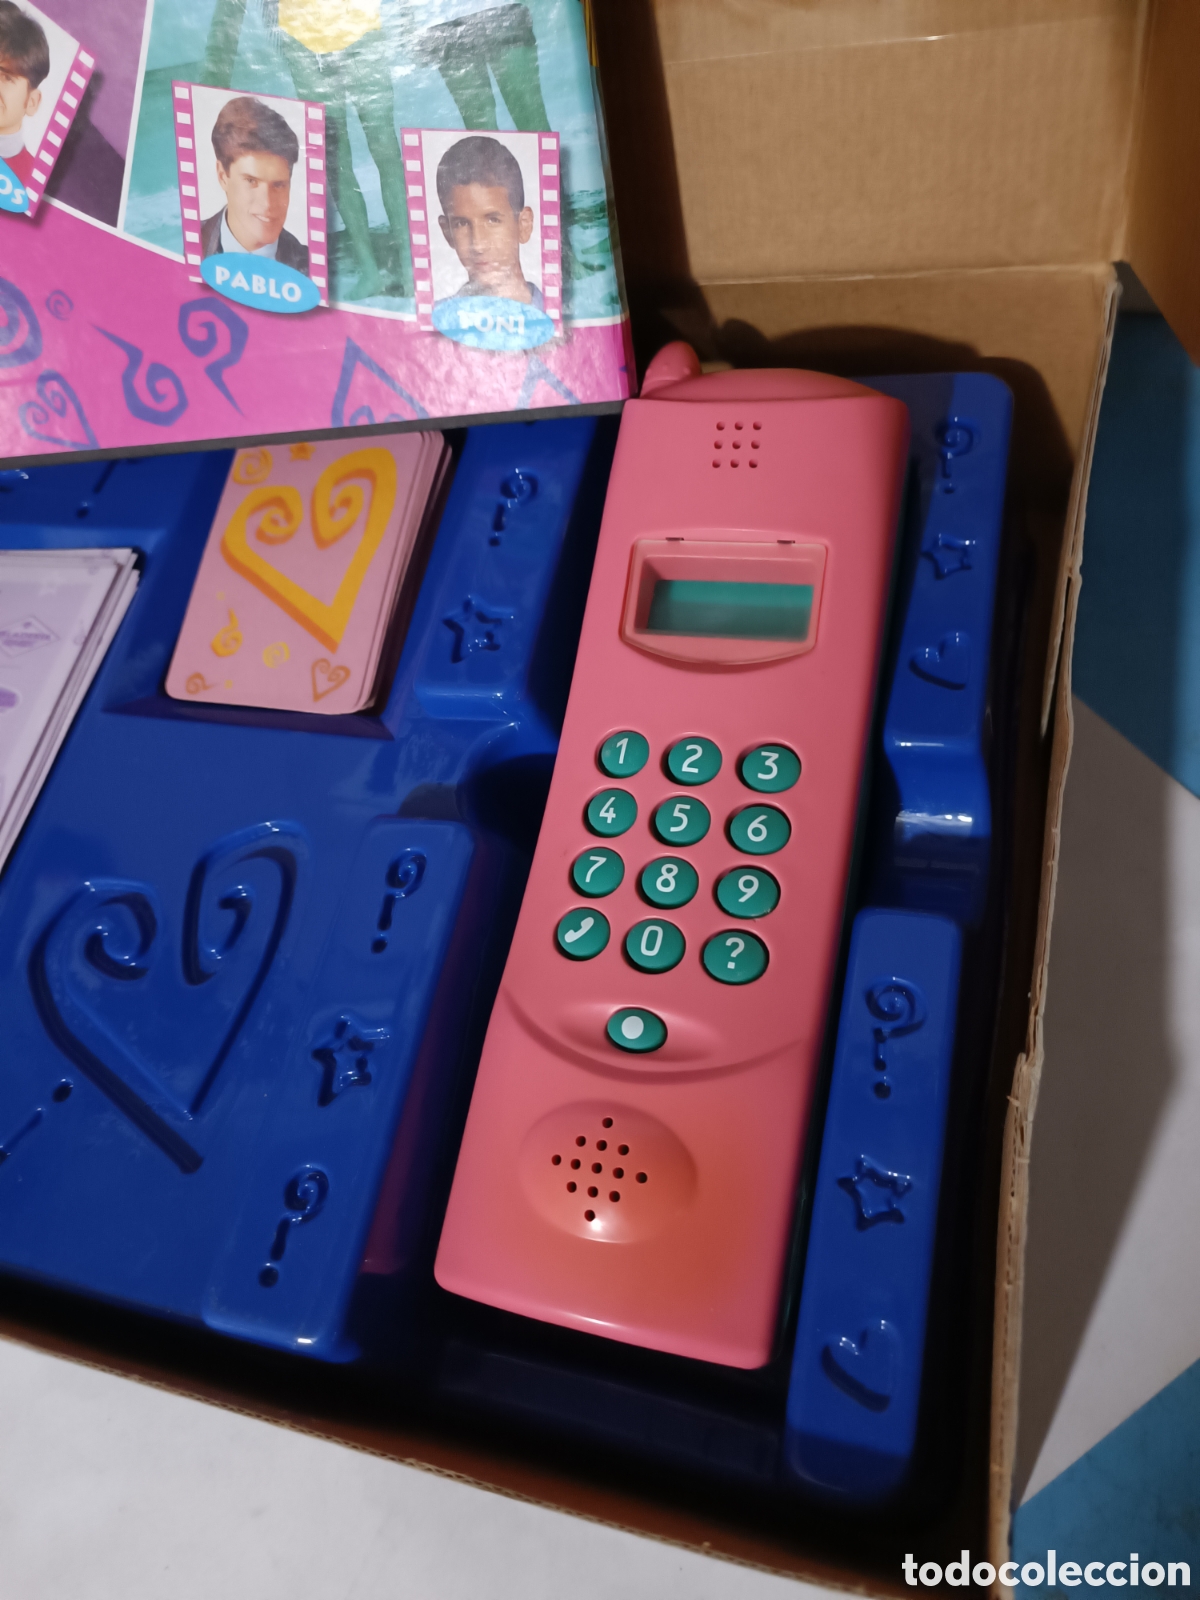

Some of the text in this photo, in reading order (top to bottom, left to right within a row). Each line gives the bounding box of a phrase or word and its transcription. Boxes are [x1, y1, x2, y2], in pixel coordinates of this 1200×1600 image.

[215, 265, 302, 303] PABLO
[616, 738, 779, 780] 1 2 3
[599, 797, 768, 842] 4 5 6
[585, 856, 759, 903] 7 8 9
[640, 925, 745, 970] 0 ?
